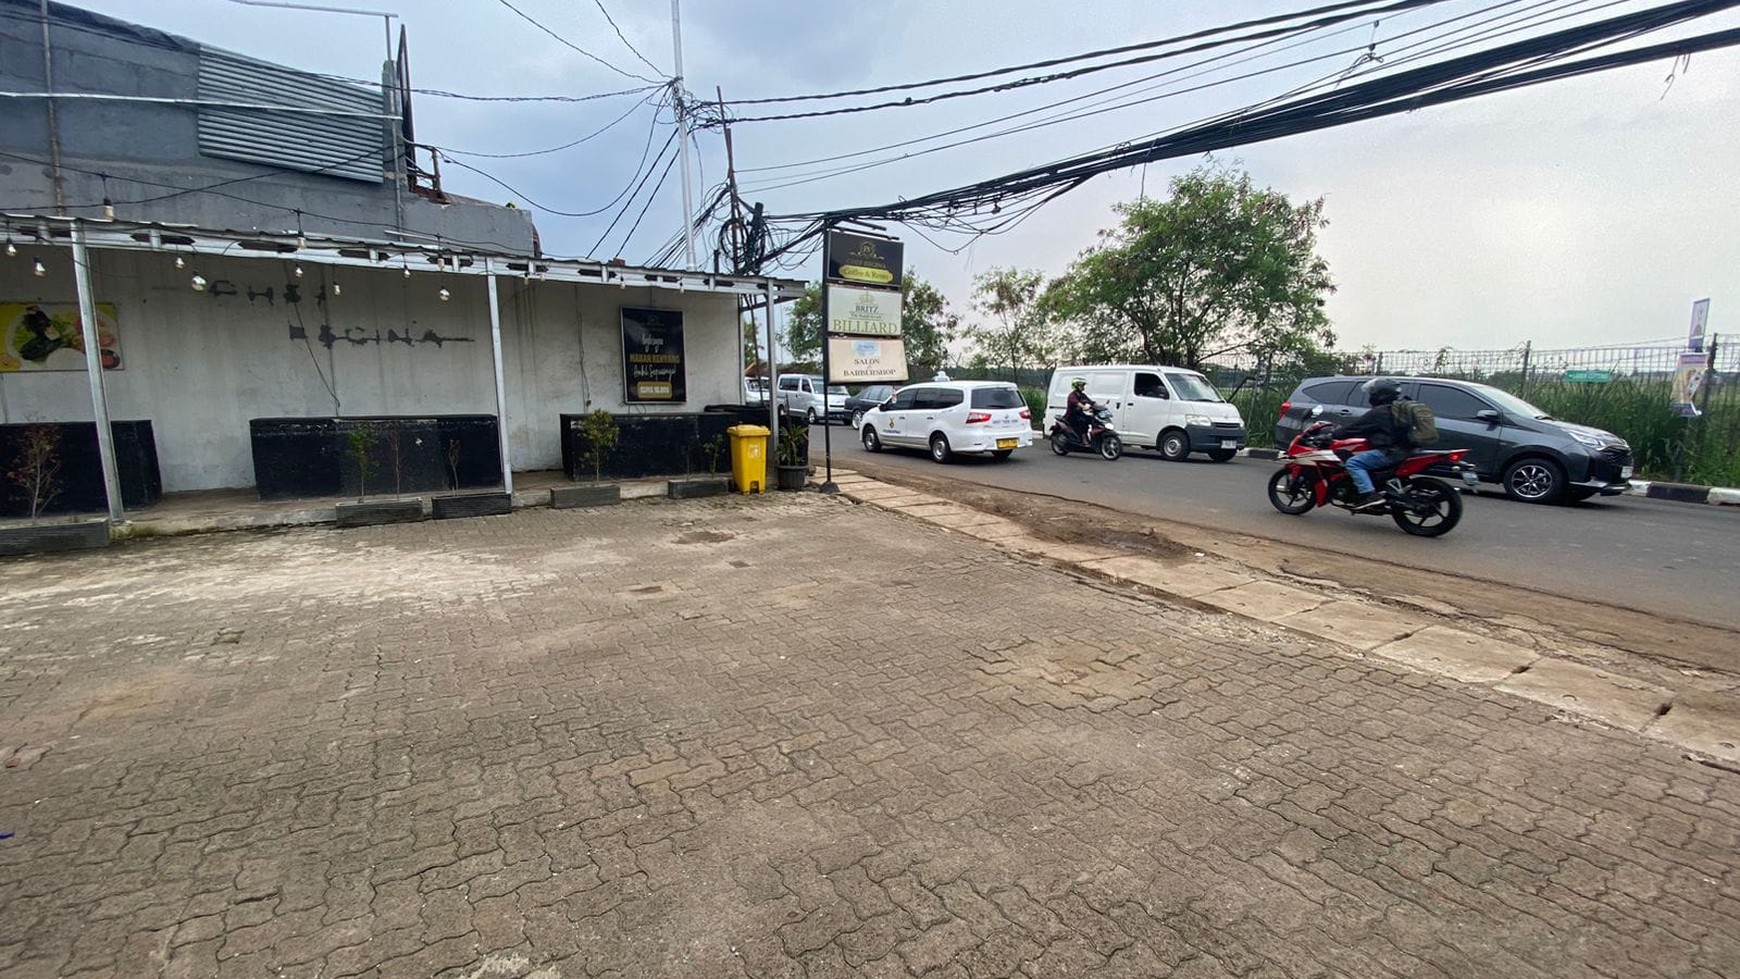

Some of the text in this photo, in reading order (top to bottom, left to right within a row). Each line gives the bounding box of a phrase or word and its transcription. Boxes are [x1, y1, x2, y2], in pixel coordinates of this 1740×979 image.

[856, 304, 879, 314] BRITZ
[833, 319, 897, 334] BILLIARD
[843, 369, 896, 377] BARBERSHOP
